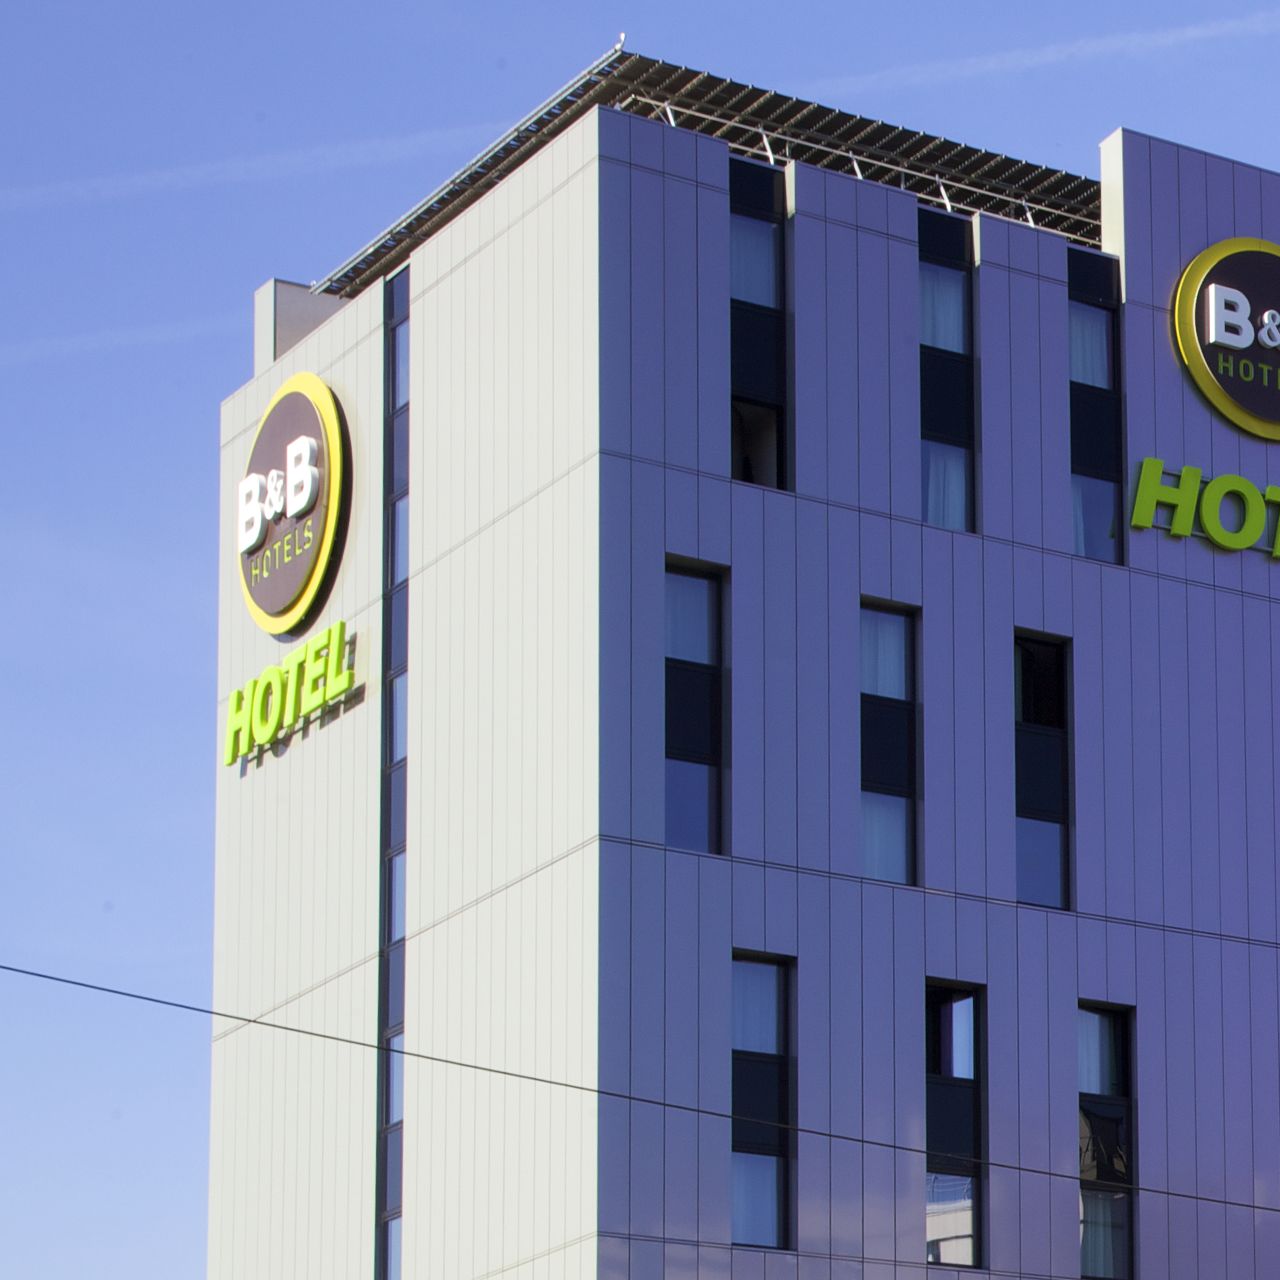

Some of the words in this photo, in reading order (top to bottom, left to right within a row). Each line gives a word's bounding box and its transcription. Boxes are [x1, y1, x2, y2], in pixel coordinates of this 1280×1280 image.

[238, 435, 320, 555] B&B
[250, 519, 314, 587] HOTELS
[224, 620, 355, 766] HOTEL
